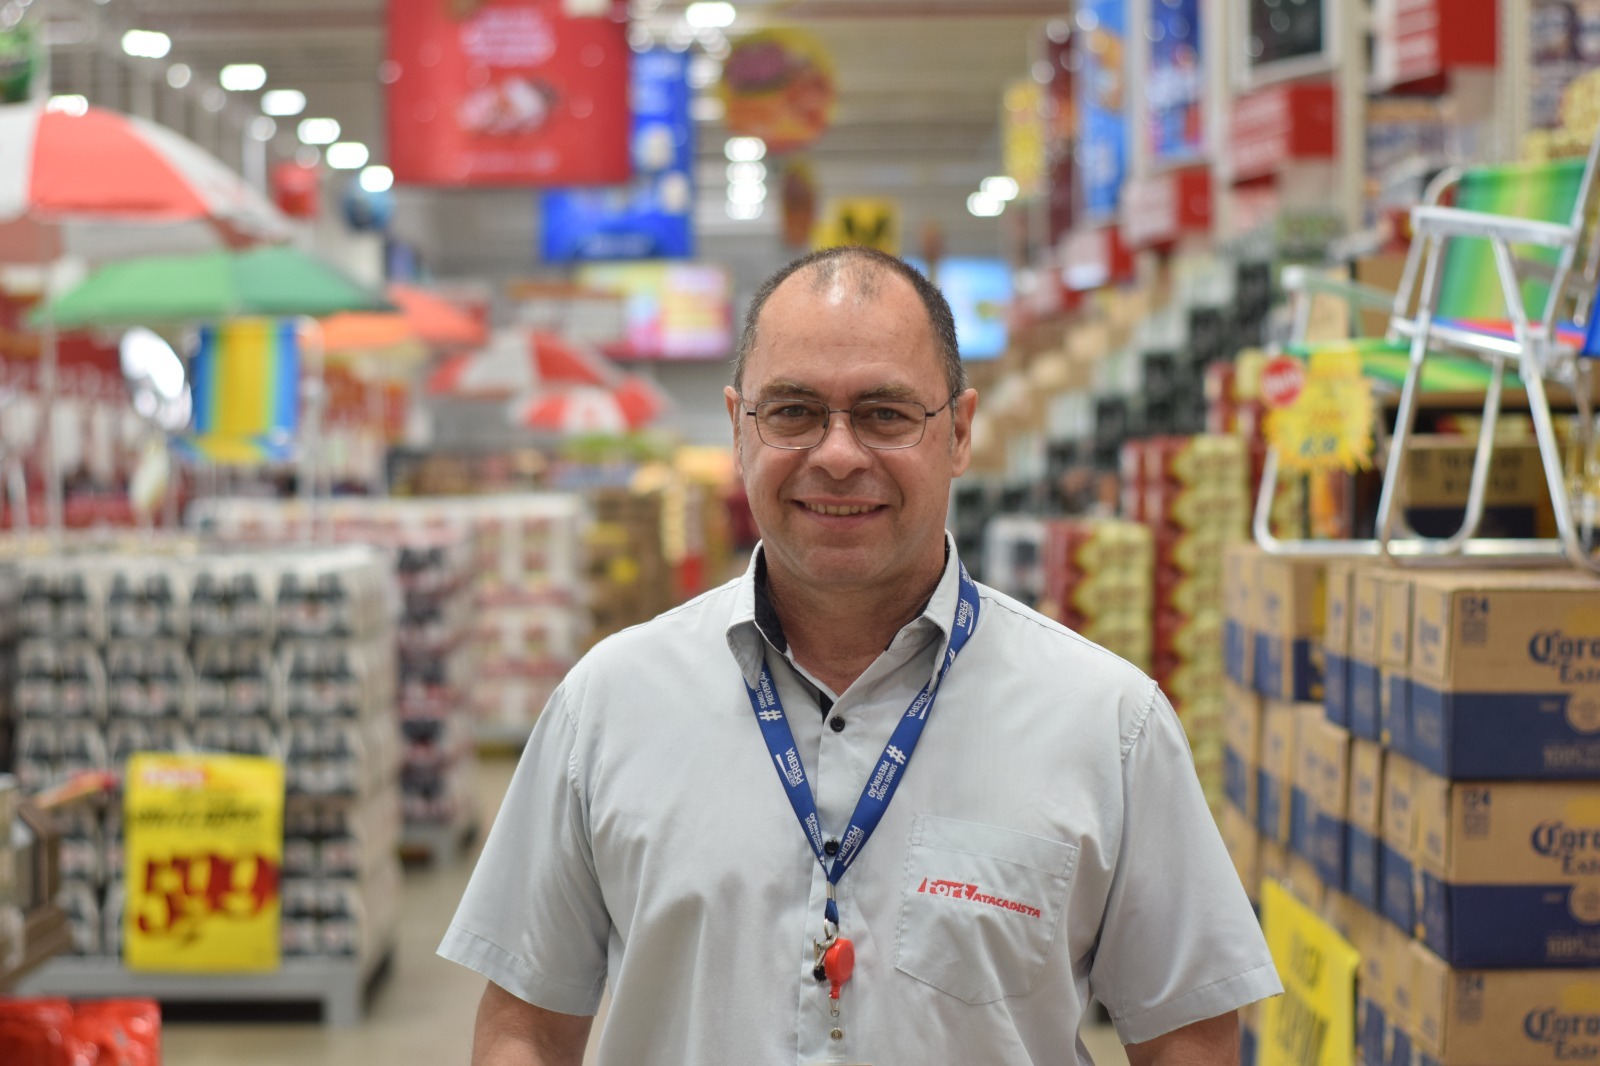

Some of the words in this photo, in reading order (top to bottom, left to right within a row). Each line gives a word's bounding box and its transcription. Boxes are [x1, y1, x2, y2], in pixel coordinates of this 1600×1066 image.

[957, 598, 969, 628] PEREIRA
[785, 747, 805, 785] PEREIRA
[867, 760, 891, 798] PREVENÇÃO
[886, 763, 898, 784] SOMOS
[876, 782, 890, 802] TODOS
[836, 824, 861, 862] PEREIRA
[917, 877, 979, 902] Fort
[972, 893, 1041, 919] ATACADISTA
